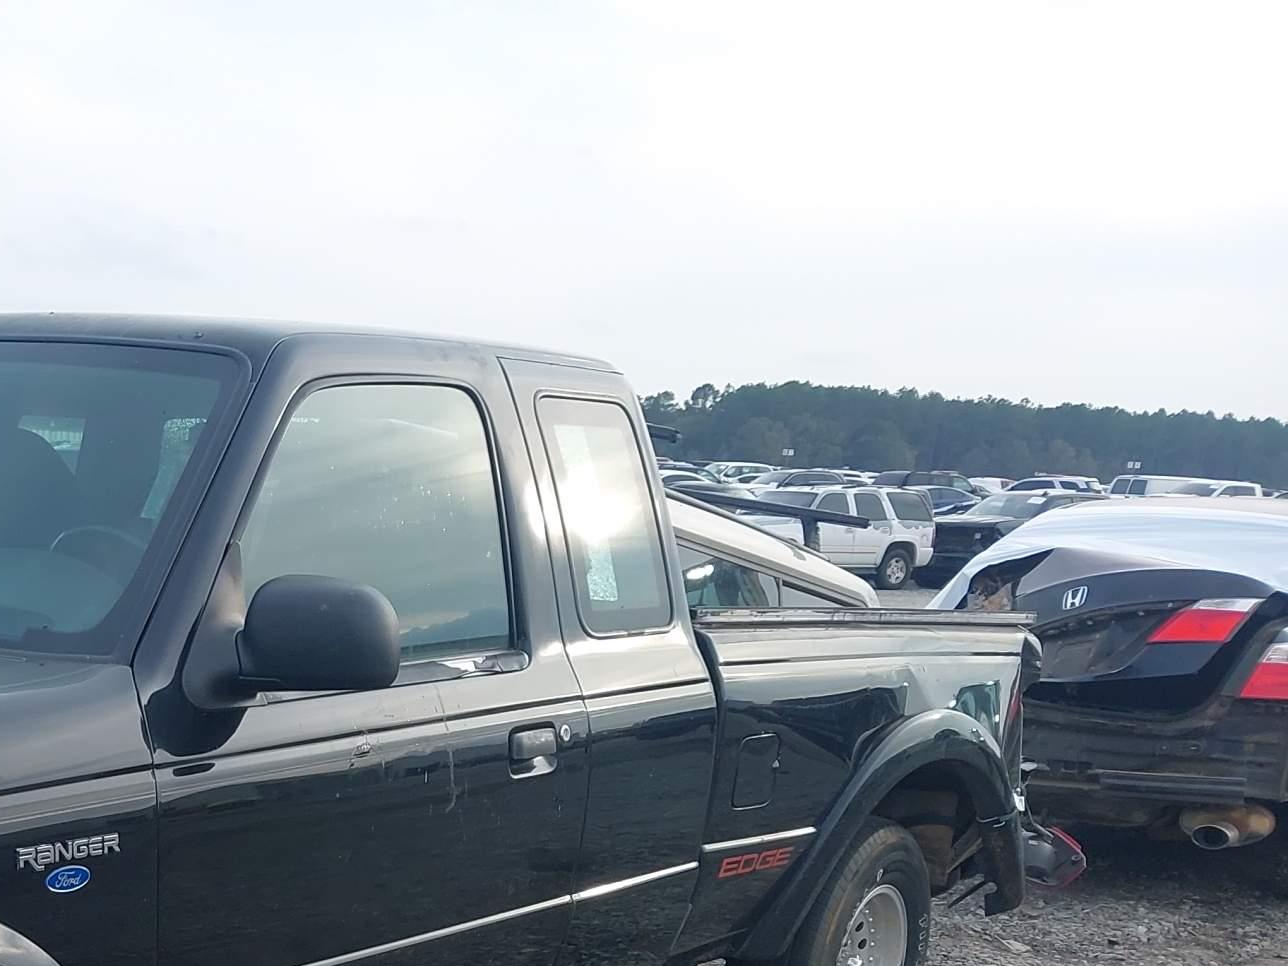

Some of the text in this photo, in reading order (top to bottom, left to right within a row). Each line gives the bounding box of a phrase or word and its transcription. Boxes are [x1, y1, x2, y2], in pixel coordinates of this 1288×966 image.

[16, 832, 121, 872] RANGER
[718, 847, 795, 878] EDGE
[54, 870, 83, 889] Ford
